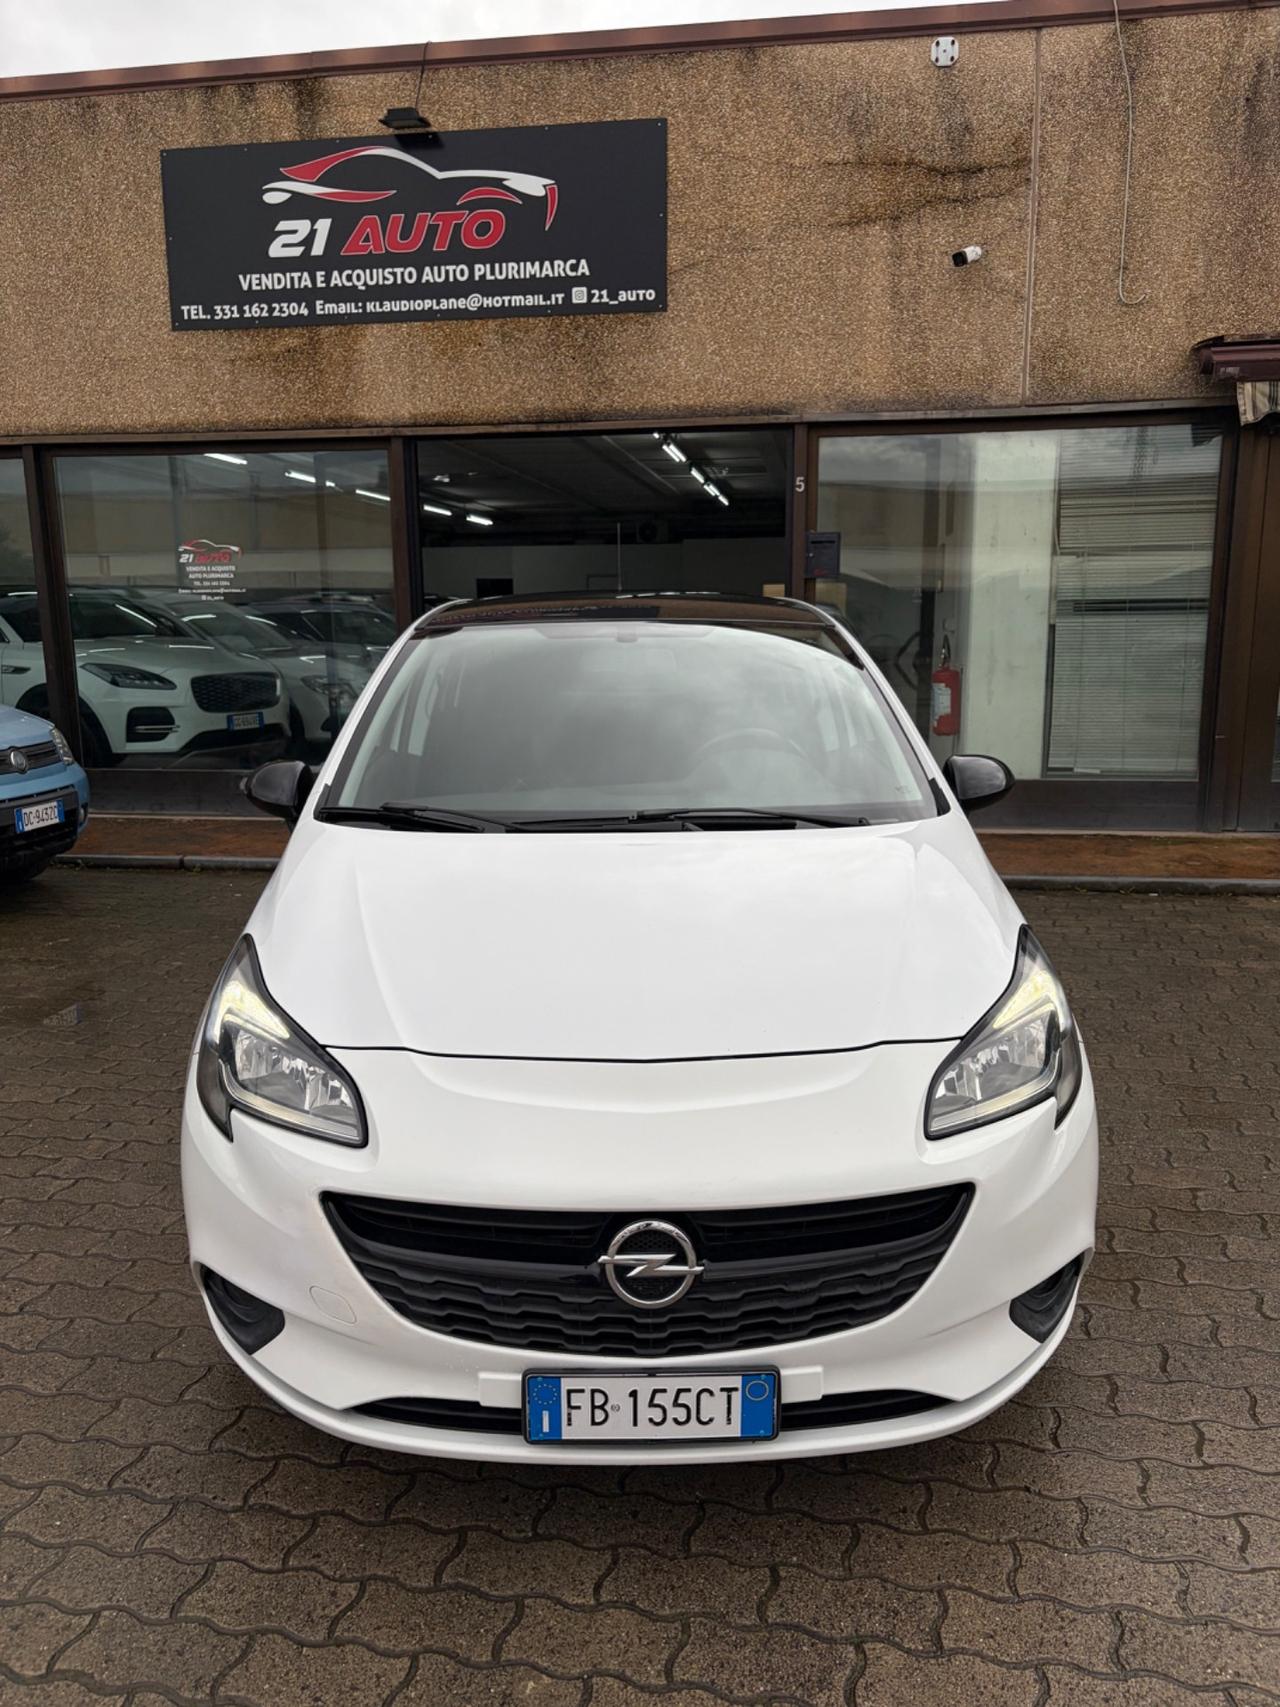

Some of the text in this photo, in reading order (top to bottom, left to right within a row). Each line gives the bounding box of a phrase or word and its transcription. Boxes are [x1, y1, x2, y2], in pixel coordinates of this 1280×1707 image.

[268, 209, 506, 258] 21 AUTO
[239, 259, 590, 291] VENDITA E ACQUISTO AUTO PLURIMARCA
[181, 304, 211, 320] TEL.
[213, 304, 240, 319] 331
[243, 303, 269, 318] 162
[271, 301, 309, 317] 2304
[795, 476, 805, 492] 5
[179, 553, 194, 563] 21
[566, 1387, 739, 1427] FB 155CT
